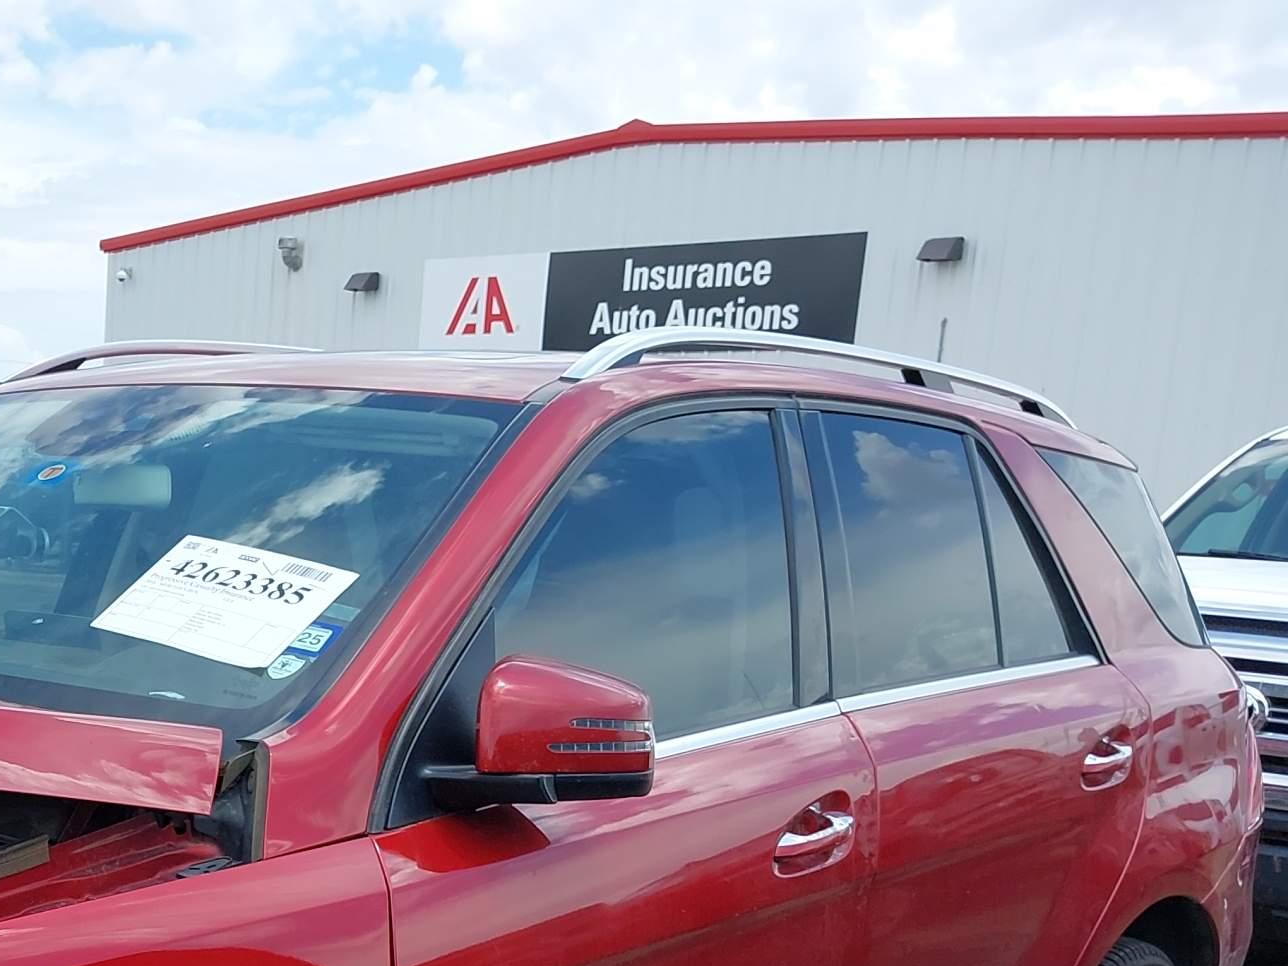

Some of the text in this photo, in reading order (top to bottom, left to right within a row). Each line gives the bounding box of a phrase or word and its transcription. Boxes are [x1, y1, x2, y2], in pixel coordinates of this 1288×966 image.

[622, 258, 773, 291] Insurance
[589, 297, 799, 335] Auto Auctions
[170, 559, 313, 605] 42623385
[296, 631, 325, 646] 25
